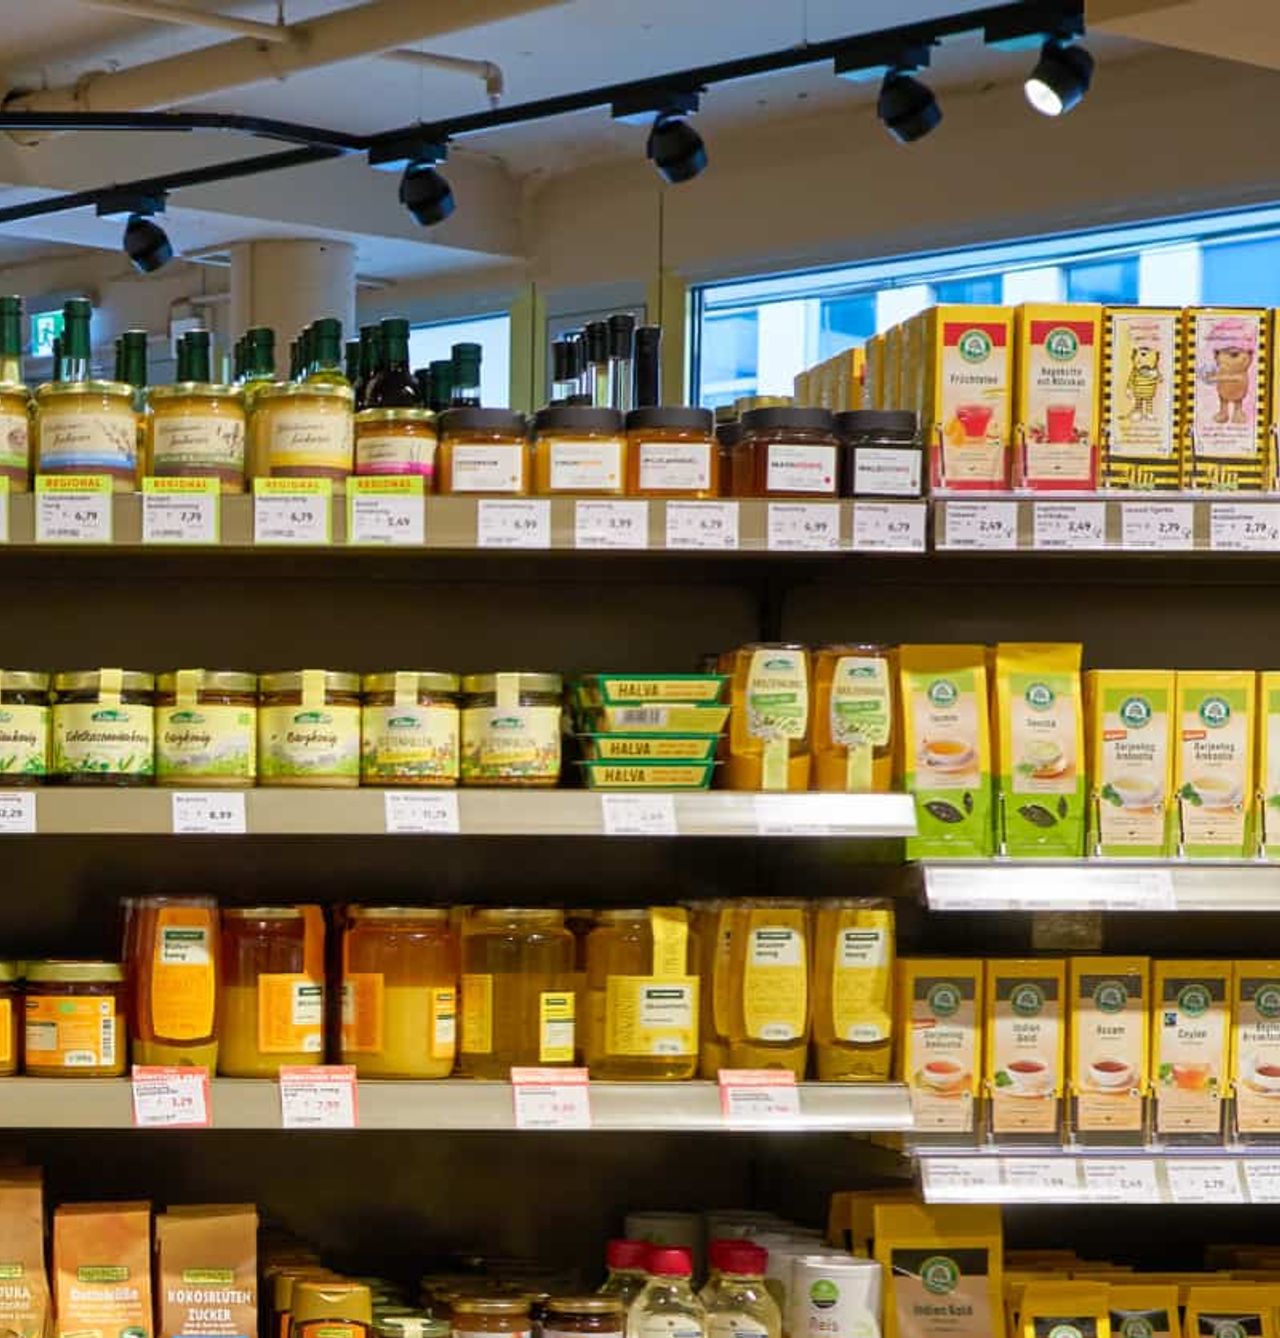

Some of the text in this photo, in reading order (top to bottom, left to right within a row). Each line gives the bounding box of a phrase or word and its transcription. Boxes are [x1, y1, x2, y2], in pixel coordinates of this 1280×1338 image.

[46, 478, 102, 487] REGIONAL
[618, 683, 659, 697] HALVA
[610, 742, 651, 756] HALVA
[604, 768, 645, 783] HALVA
[167, 1289, 251, 1304] KOKOSBLÜTEN
[188, 1309, 231, 1321] ZUCKER
